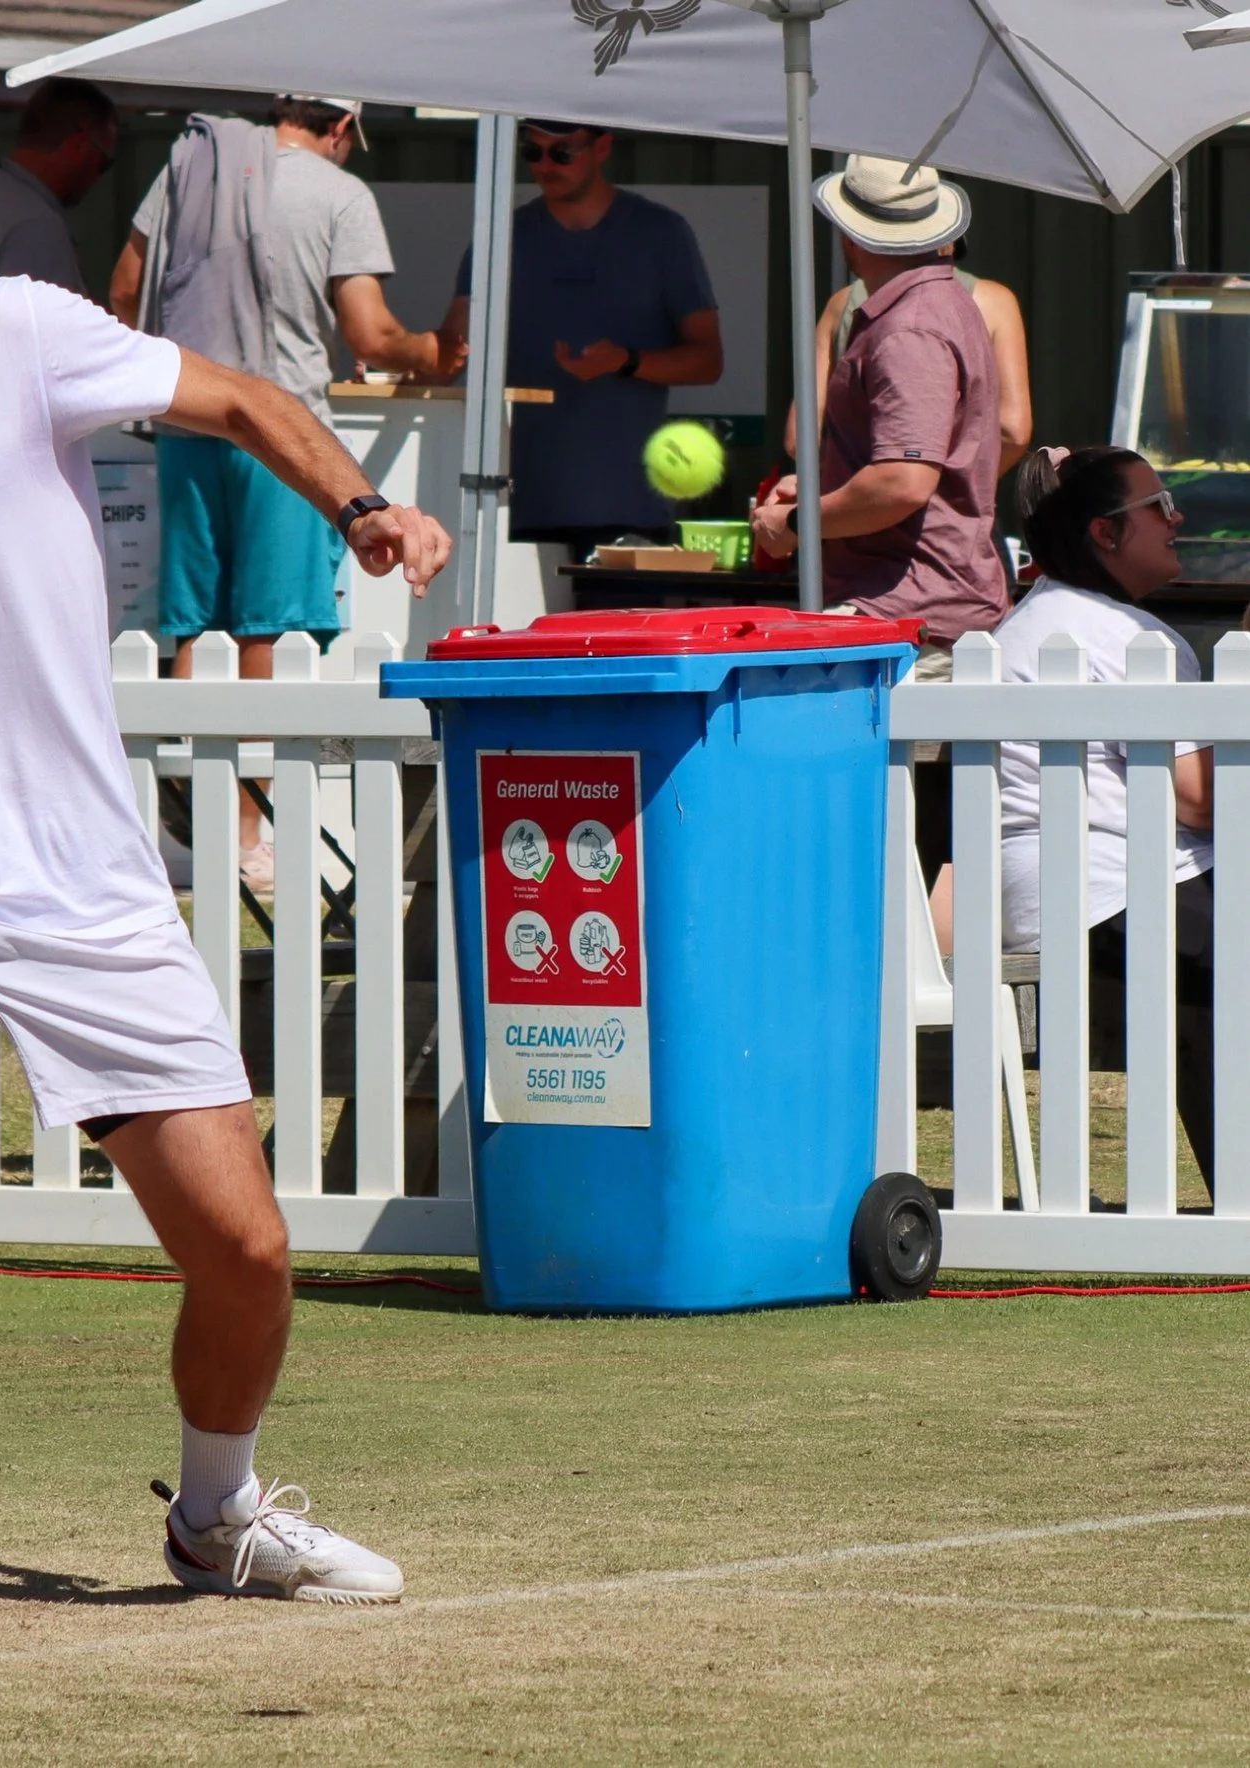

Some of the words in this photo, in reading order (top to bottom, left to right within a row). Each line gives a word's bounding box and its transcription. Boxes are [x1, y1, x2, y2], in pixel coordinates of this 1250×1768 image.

[102, 505, 146, 522] CHIPS
[497, 779, 558, 798] General
[564, 781, 619, 799] Waste
[505, 1025, 618, 1048] CLEANAWAY
[526, 1068, 566, 1089] 5561
[571, 1069, 606, 1090] 1195
[526, 1091, 606, 1104] cleanaway.com.au
